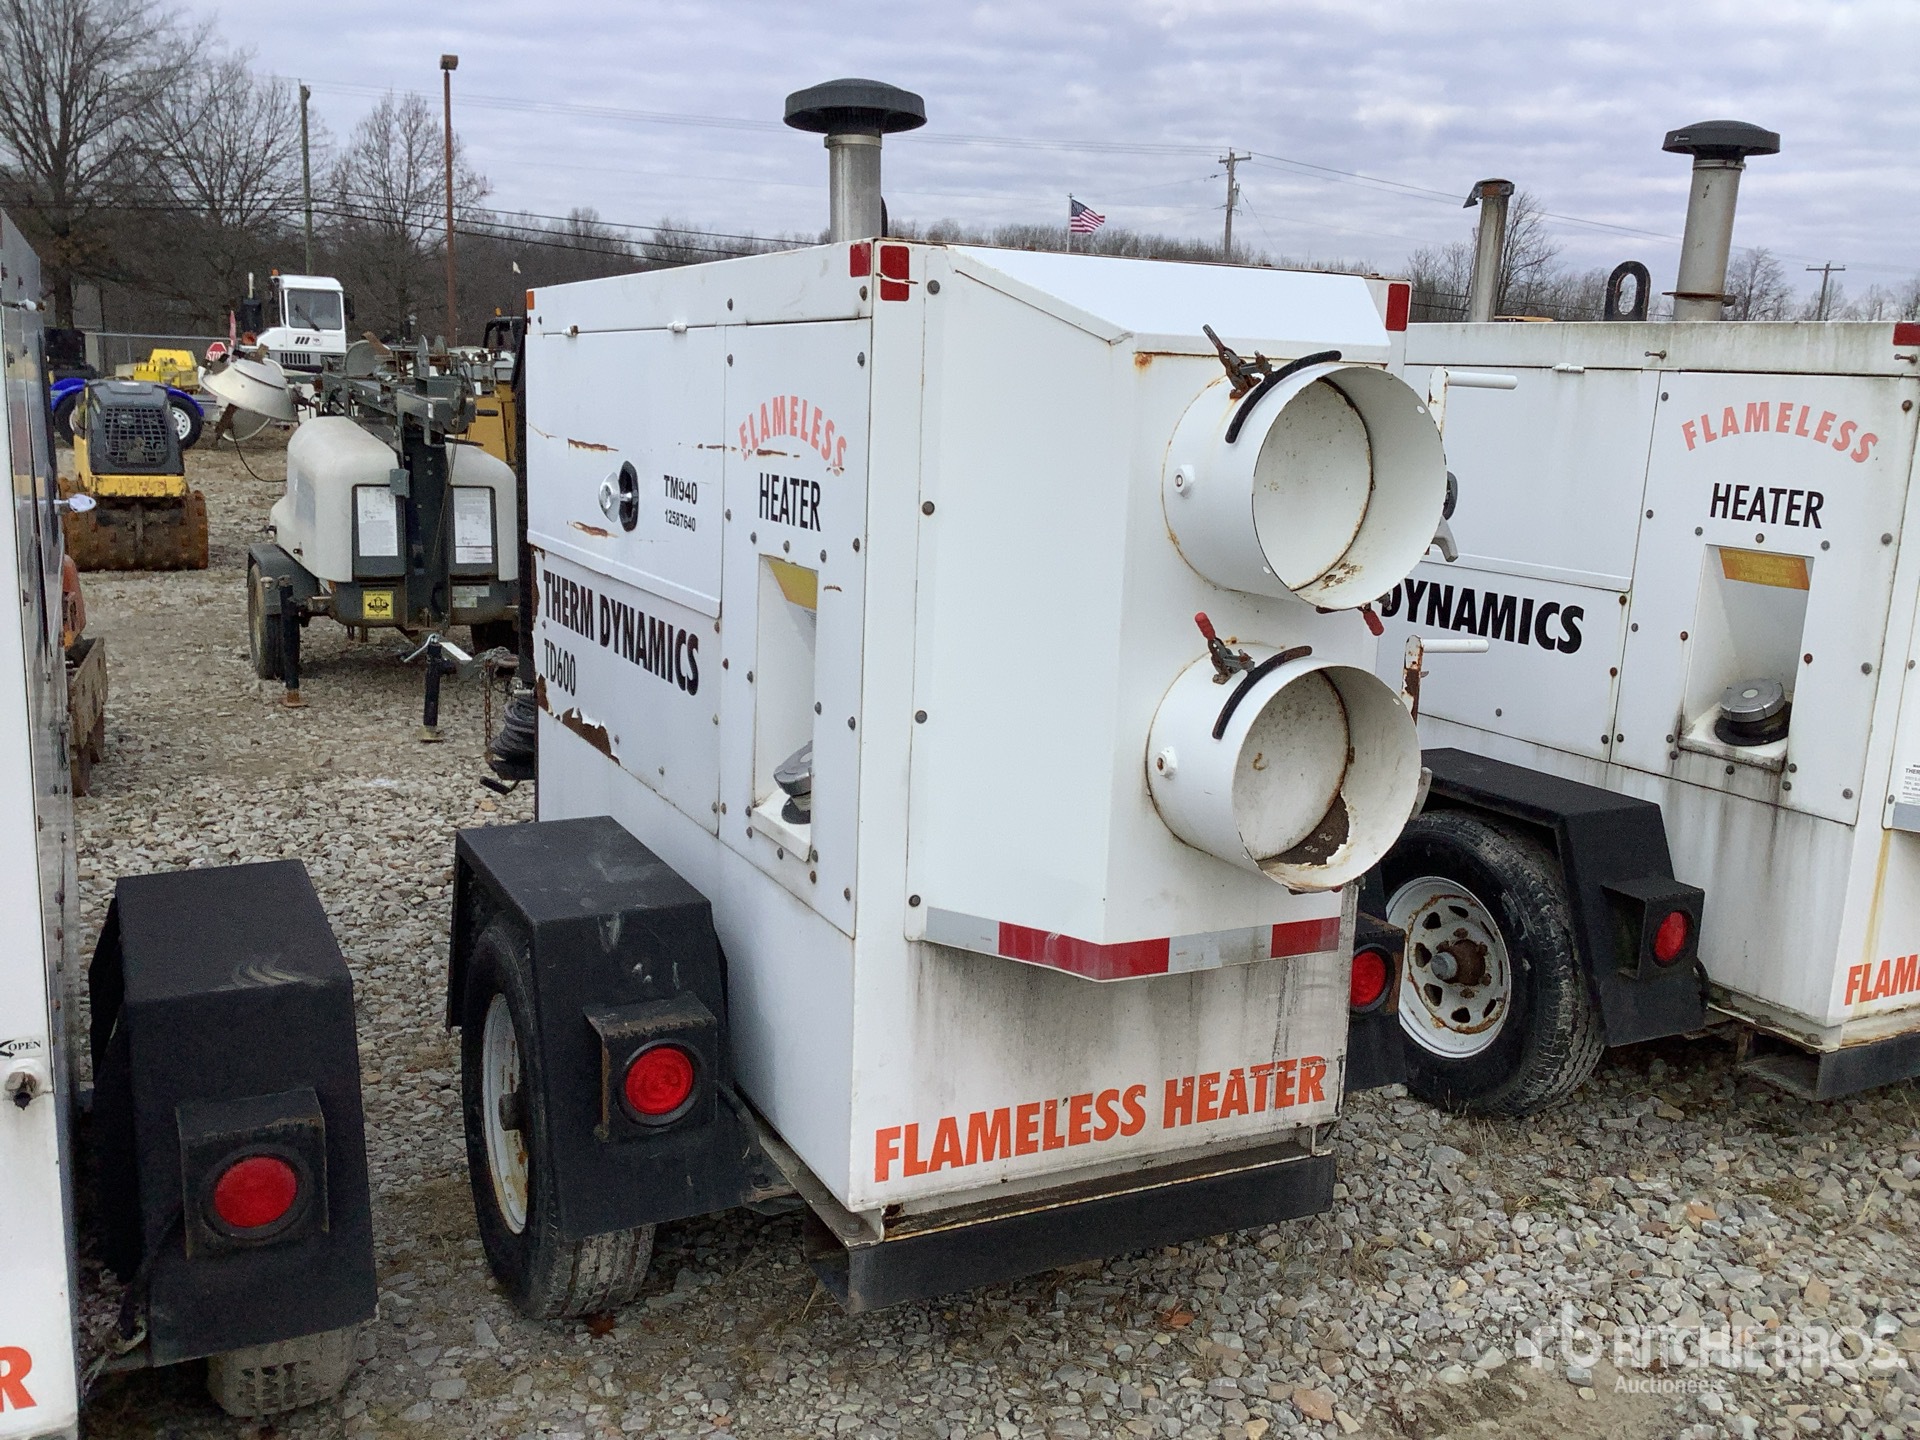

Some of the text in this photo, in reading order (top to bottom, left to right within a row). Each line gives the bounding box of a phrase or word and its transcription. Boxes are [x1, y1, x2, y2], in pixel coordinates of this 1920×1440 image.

[739, 395, 847, 477] FLAMELESS
[1681, 401, 1879, 464] FLAMELESS
[663, 474, 698, 505] TM940
[759, 472, 822, 532] HEATER
[1710, 483, 1824, 529] HEATER
[664, 508, 697, 532] 12587640
[543, 569, 699, 696] THERM DYNAMICS
[544, 638, 576, 697] TD600
[1844, 953, 1920, 1006] FLAM
[8, 1040, 42, 1052] OPEN
[874, 1055, 1328, 1184] FLAMELESS HEATER
